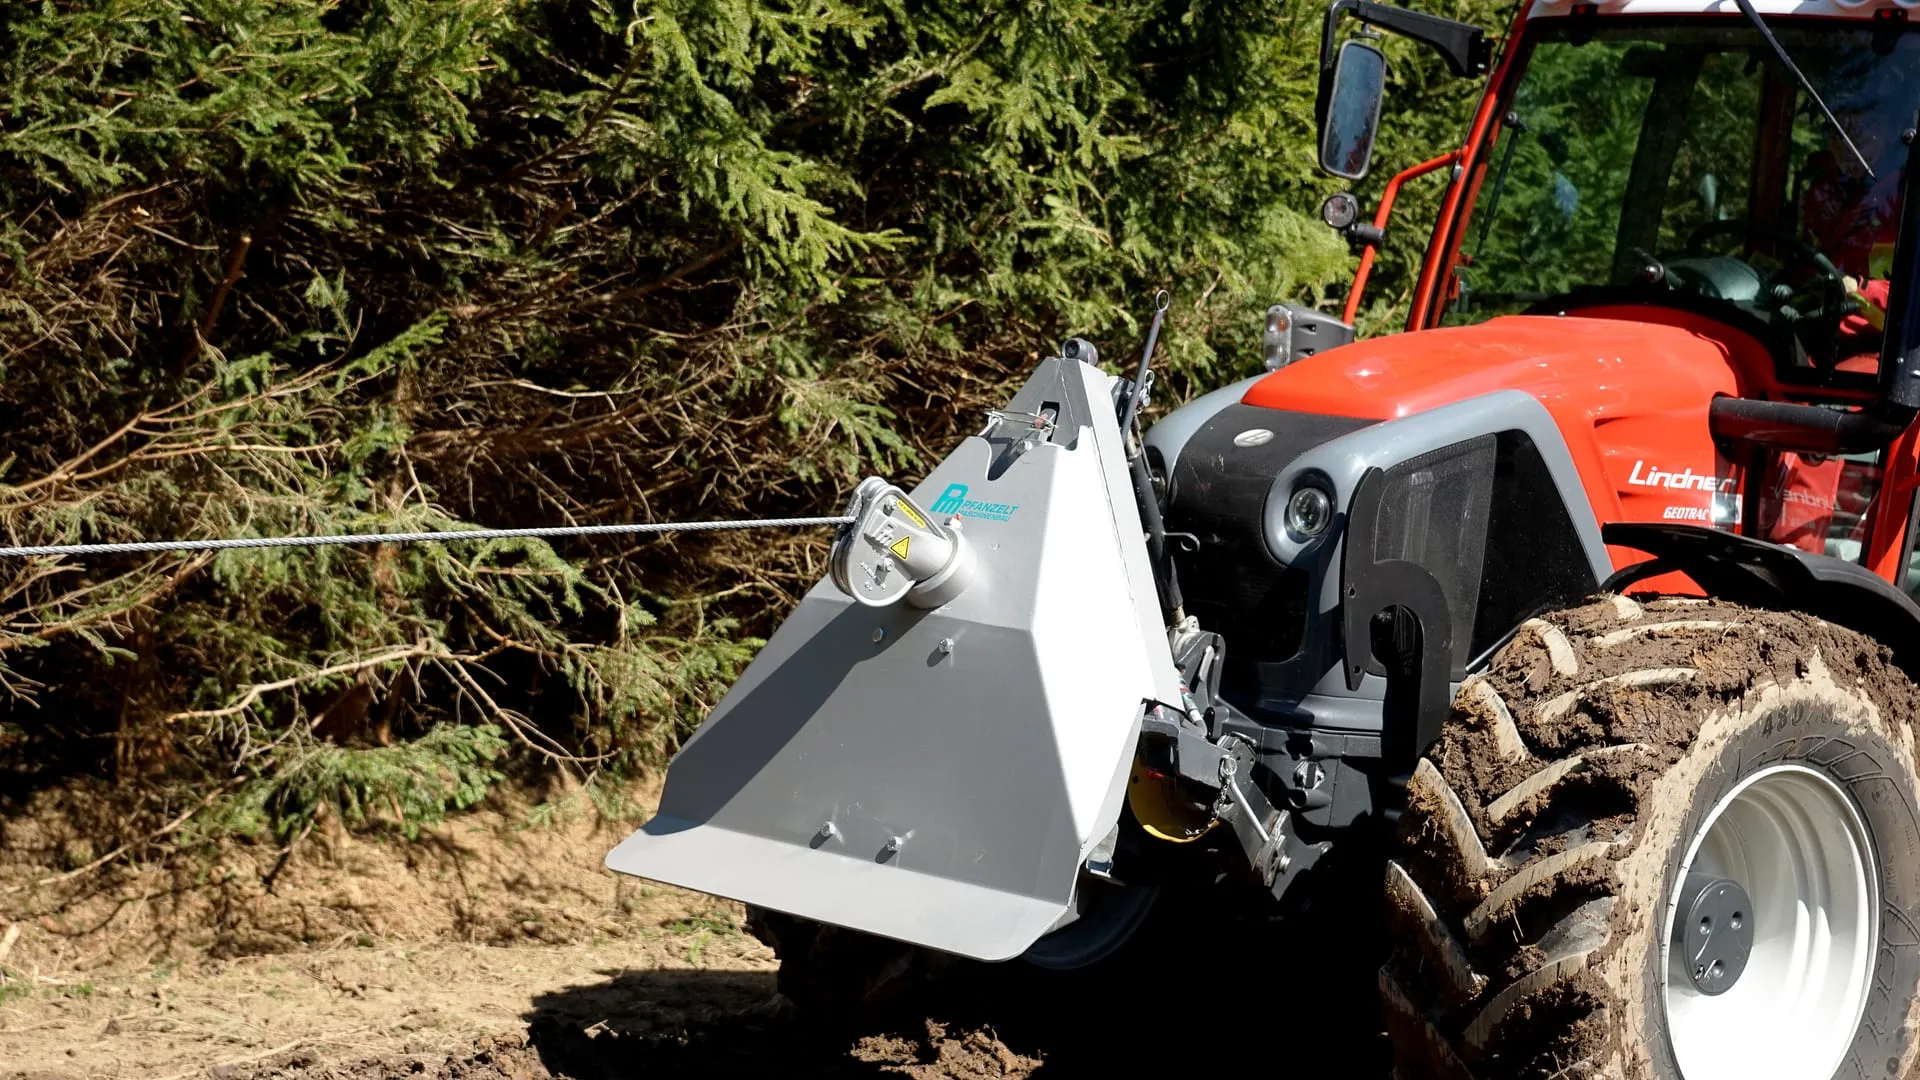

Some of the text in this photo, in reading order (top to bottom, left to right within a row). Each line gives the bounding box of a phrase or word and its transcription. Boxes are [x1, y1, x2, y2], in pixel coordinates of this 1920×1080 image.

[1628, 460, 1736, 491] Lindner
[961, 500, 1019, 515] PFANZELT
[1663, 507, 1709, 520] GEOTRAC
